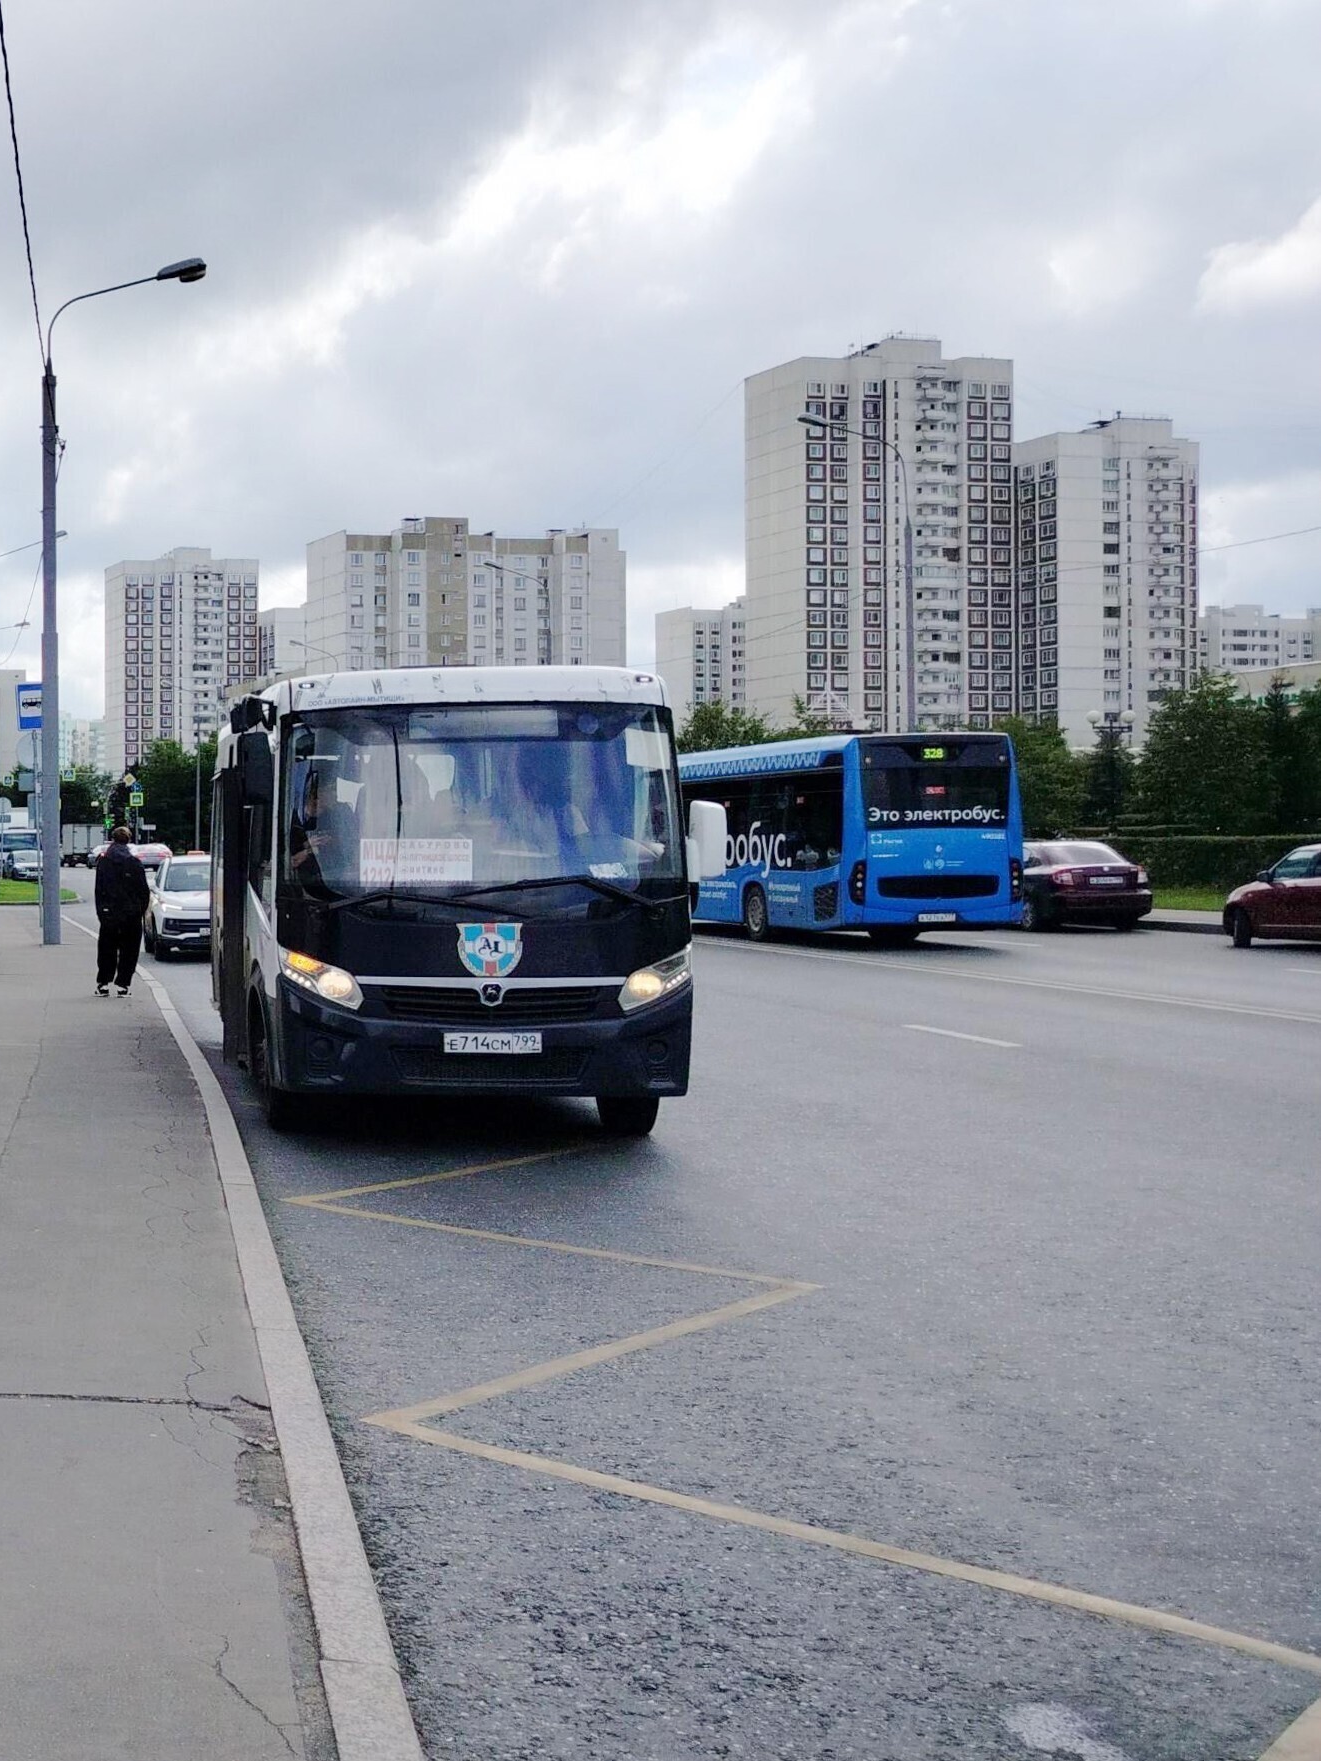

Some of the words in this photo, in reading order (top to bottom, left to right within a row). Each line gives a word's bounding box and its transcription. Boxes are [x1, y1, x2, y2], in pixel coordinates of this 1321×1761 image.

[923, 747, 944, 759] 328
[868, 807, 900, 822] Это
[903, 805, 1005, 823] электробус.
